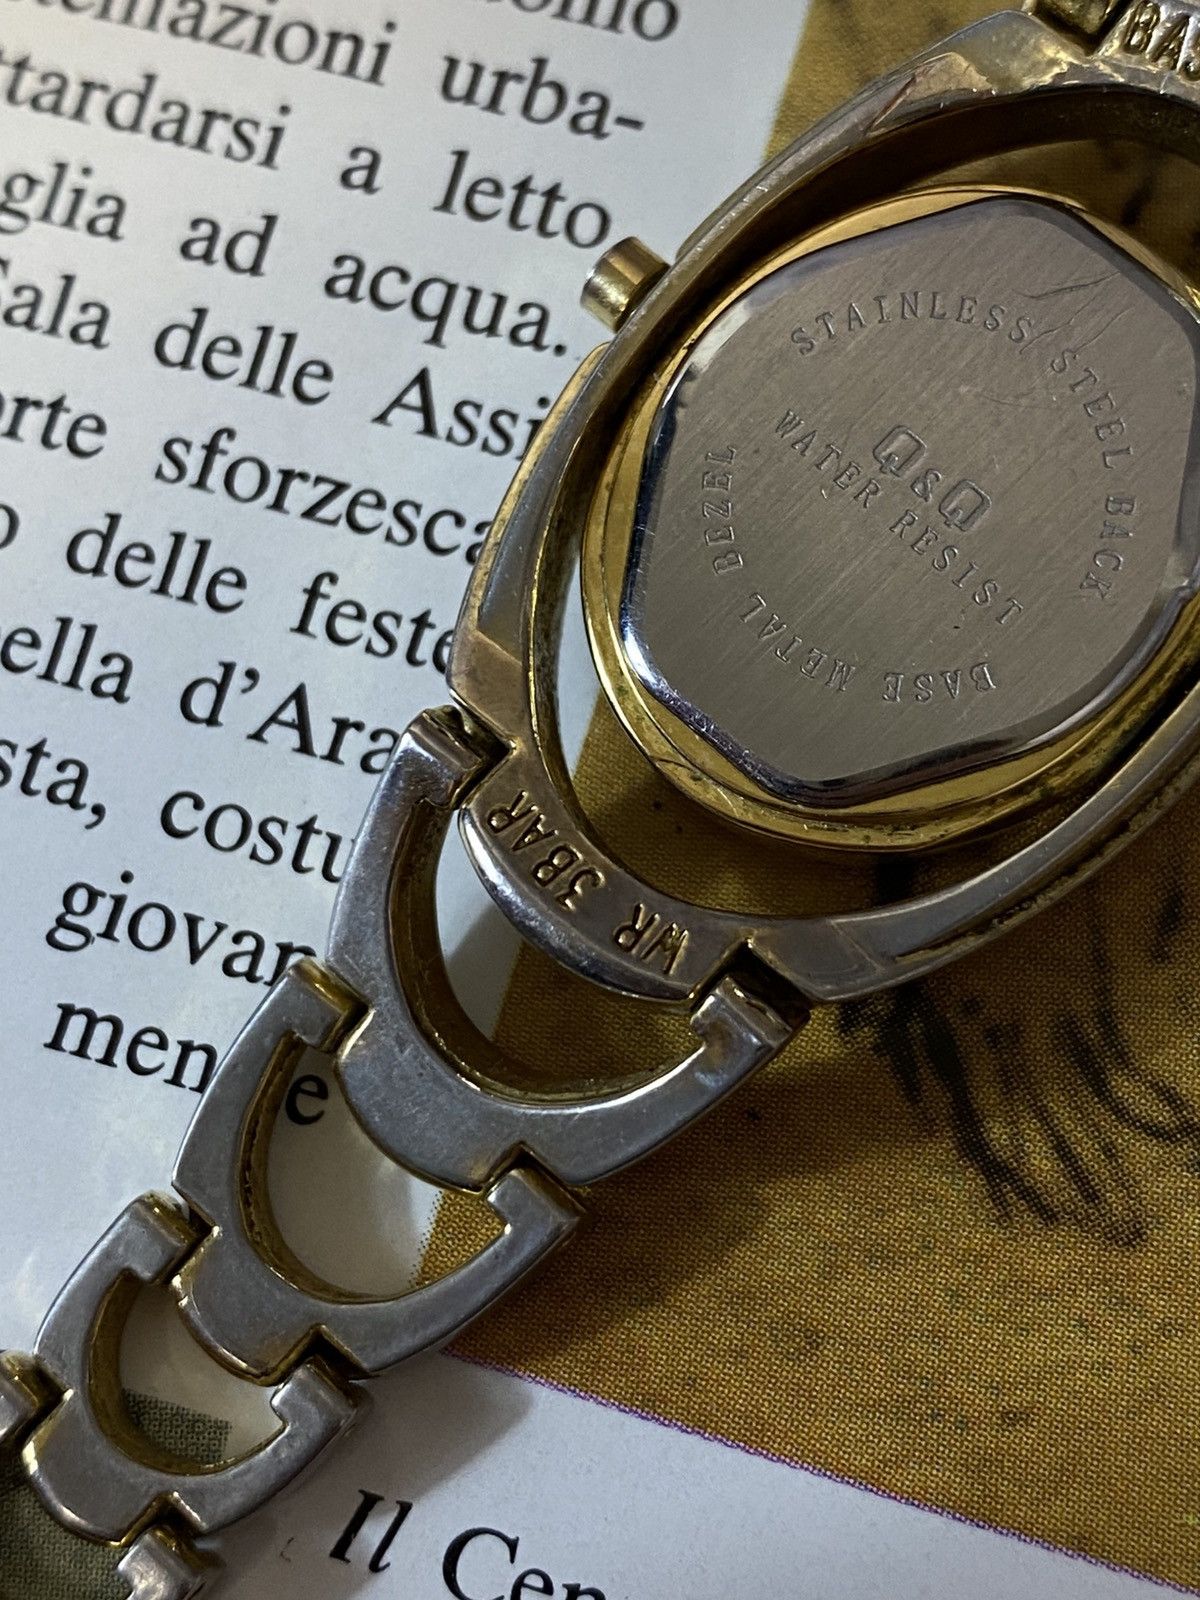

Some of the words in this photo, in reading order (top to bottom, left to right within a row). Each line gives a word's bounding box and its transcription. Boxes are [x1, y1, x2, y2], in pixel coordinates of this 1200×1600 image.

[440, 55, 645, 140] urba-
[0, 50, 292, 171] tardarsi
[340, 146, 382, 195] a
[432, 149, 612, 249] letto
[0, 162, 127, 241] glia
[179, 214, 279, 278] ad
[323, 253, 567, 357] acqua.
[0, 257, 110, 350] ala
[153, 307, 334, 406] delle
[790, 291, 1034, 356] STAINLESS
[0, 388, 107, 460] rte
[1049, 346, 1134, 470] STEEL
[701, 444, 744, 576] BEZEL
[775, 408, 882, 509] WATER
[889, 508, 1024, 625] RESIST
[872, 424, 993, 532] Q&Q
[66, 512, 248, 614] delle
[1079, 494, 1137, 600] BACK
[0, 616, 134, 704] ella
[739, 592, 857, 692] METAL
[882, 661, 997, 704] BASE
[613, 903, 689, 976] WR
[329, 1489, 413, 1574] Il
